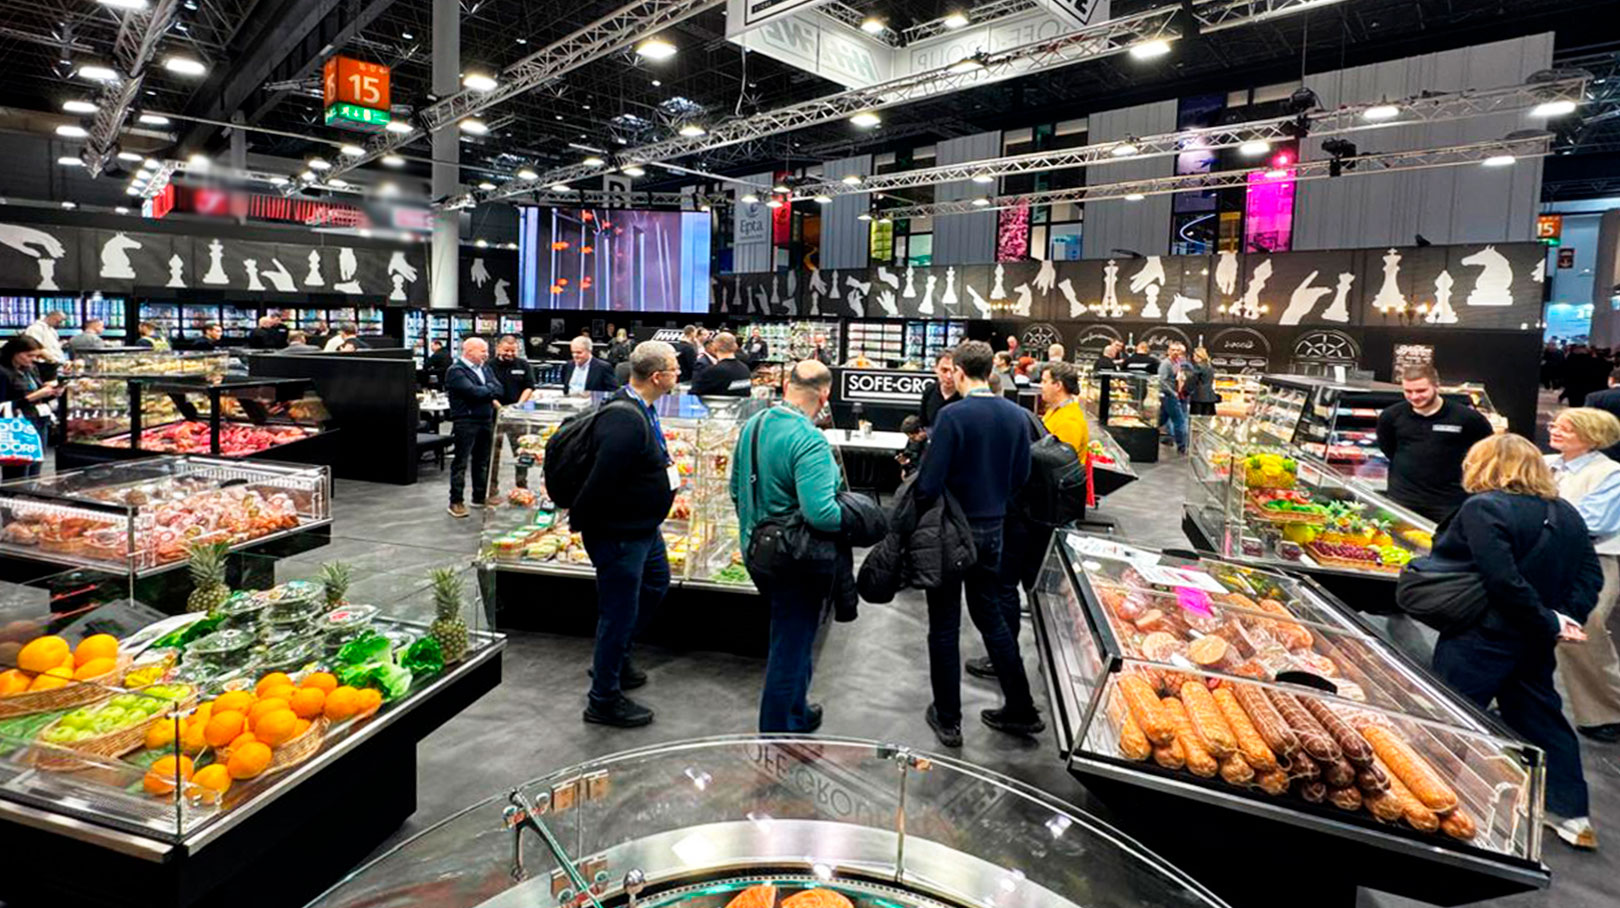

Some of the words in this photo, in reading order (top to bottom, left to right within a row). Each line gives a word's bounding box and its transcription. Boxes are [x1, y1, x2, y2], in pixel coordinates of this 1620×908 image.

[348, 74, 381, 104] 15
[740, 219, 763, 236] Epta
[1536, 222, 1555, 236] 15
